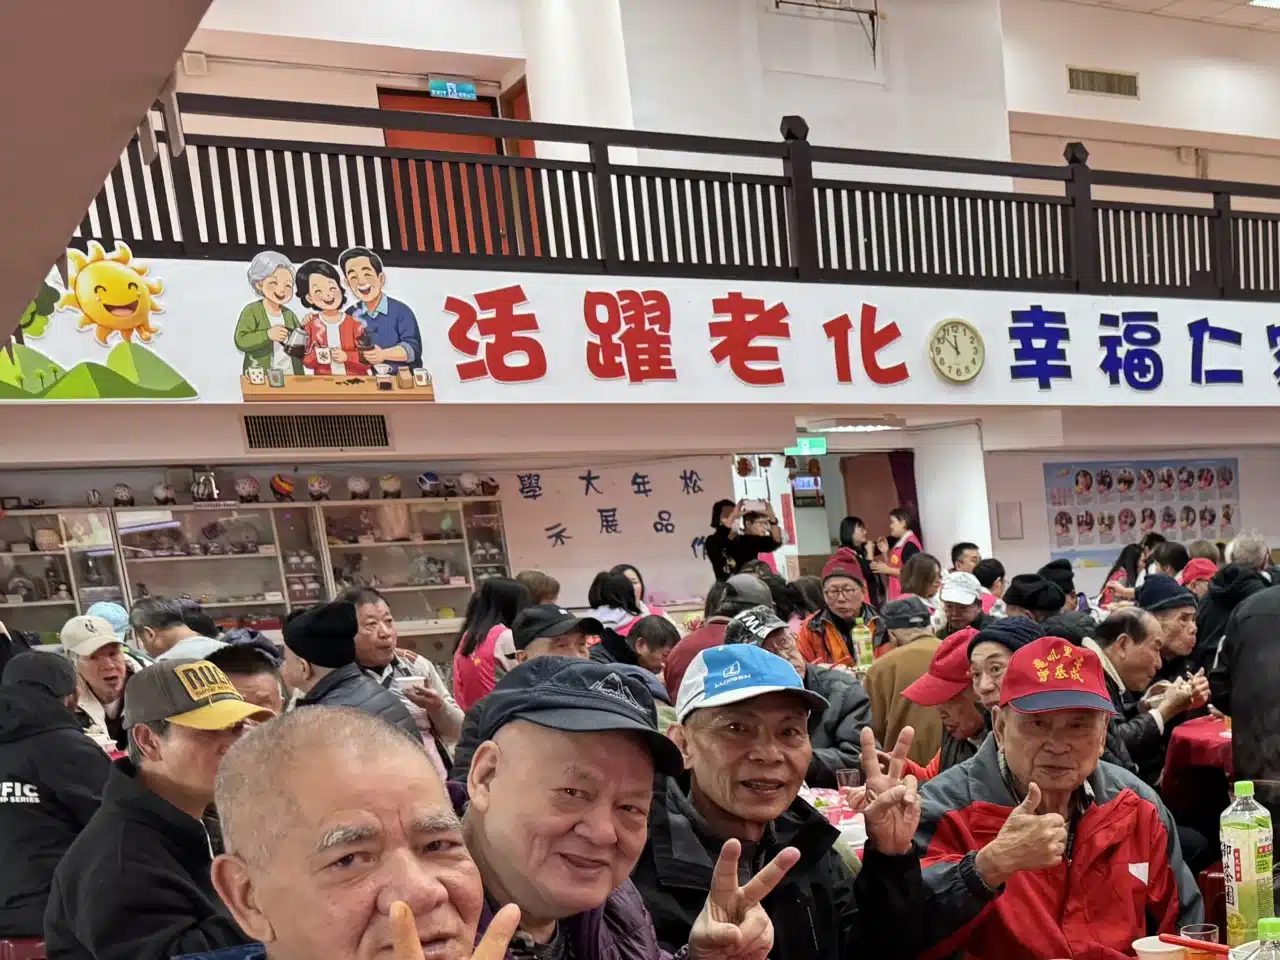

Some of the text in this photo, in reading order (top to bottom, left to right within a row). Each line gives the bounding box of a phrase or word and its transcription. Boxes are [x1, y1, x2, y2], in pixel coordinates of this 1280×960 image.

[444, 284, 910, 386] 活躍老化
[0, 782, 40, 797] FIC
